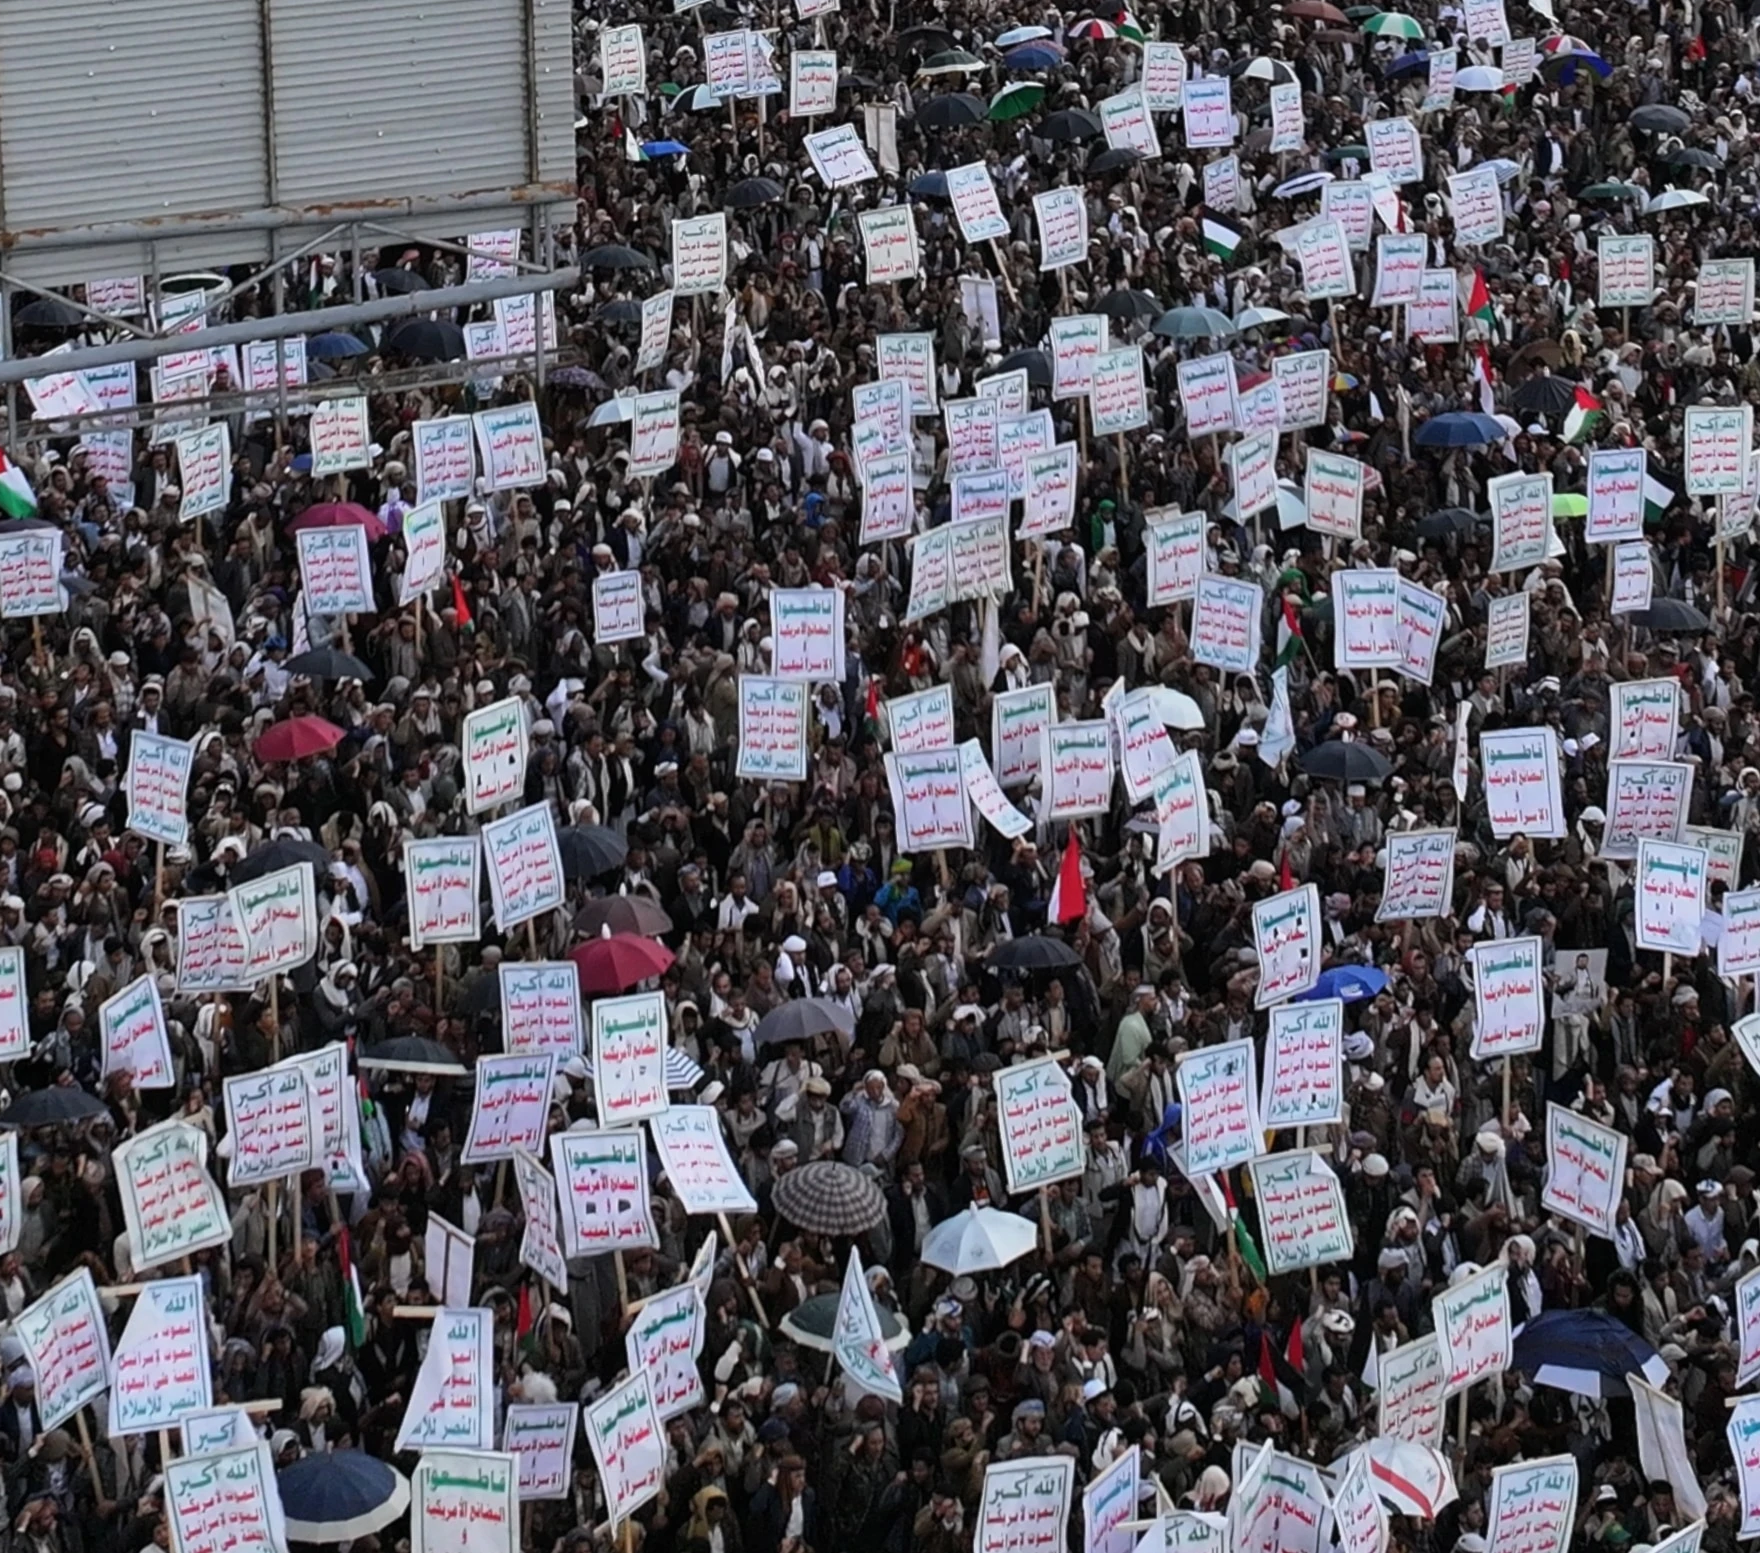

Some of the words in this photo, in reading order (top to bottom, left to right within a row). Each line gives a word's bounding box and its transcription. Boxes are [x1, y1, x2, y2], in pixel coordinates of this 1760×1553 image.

[1053, 733, 1107, 756] قاطعوا
[1486, 743, 1542, 766] قاطعوا
[901, 759, 958, 782] قاطعوا
[1483, 949, 1534, 979] قاطعوا
[600, 1009, 658, 1038] قاطعوا
[280, 1073, 303, 1093] الله
[483, 1062, 546, 1090] قاطعوا
[277, 1095, 307, 1112] الموت
[277, 1115, 307, 1133] الموت
[1555, 1117, 1612, 1160] قاطعوا
[568, 1144, 637, 1170] قاطعوا
